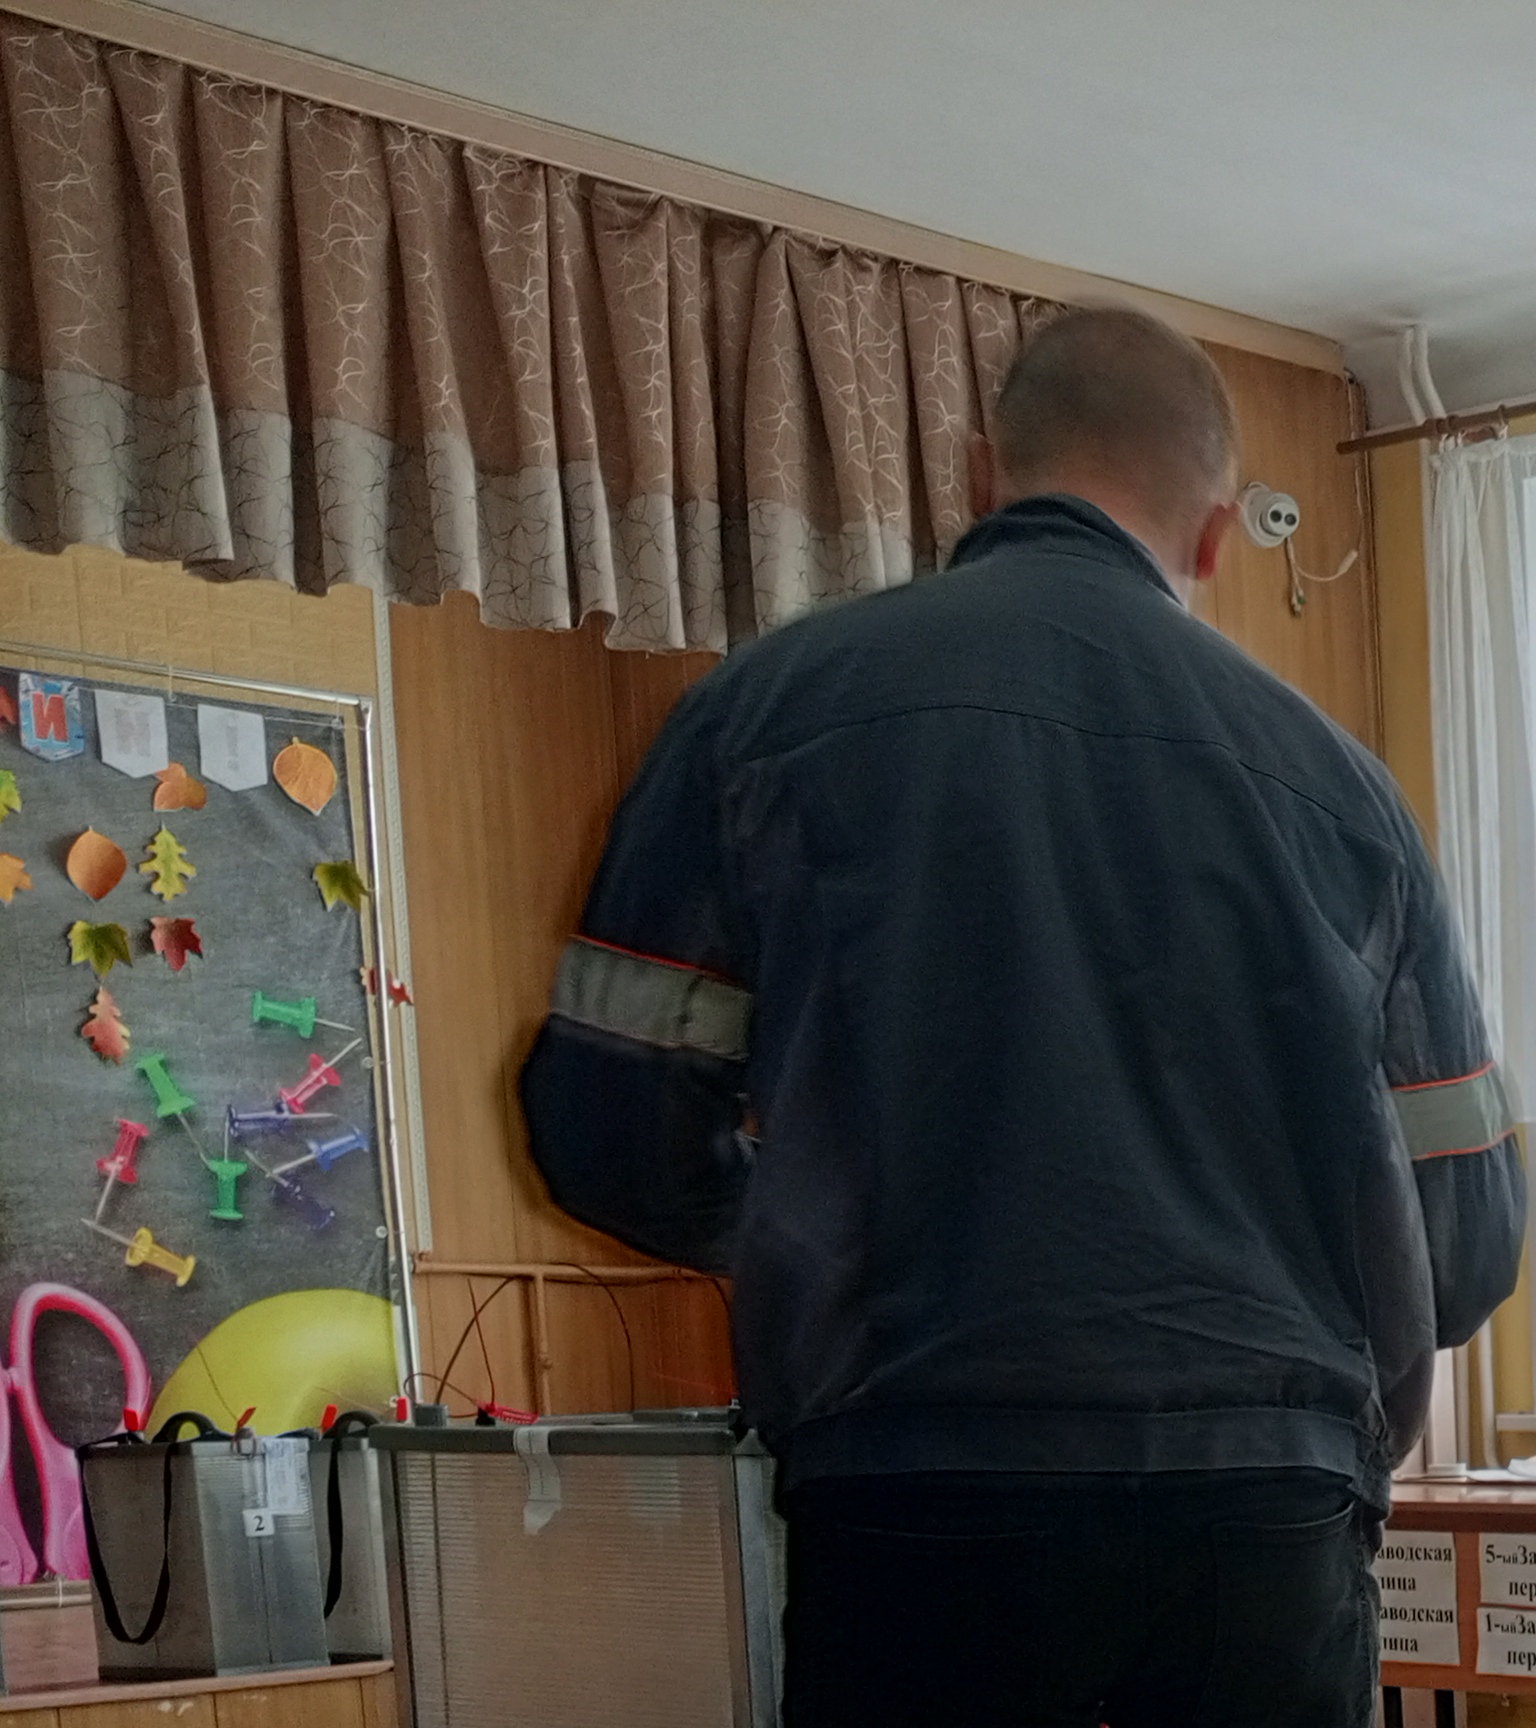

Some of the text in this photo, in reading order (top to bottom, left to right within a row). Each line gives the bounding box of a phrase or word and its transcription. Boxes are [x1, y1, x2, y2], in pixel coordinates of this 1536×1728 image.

[253, 1515, 265, 1531] 2
[1377, 1546, 1453, 1562] аводская
[1380, 1577, 1416, 1592] ица
[1380, 1607, 1454, 1624] аводская
[1383, 1637, 1418, 1652] ица
